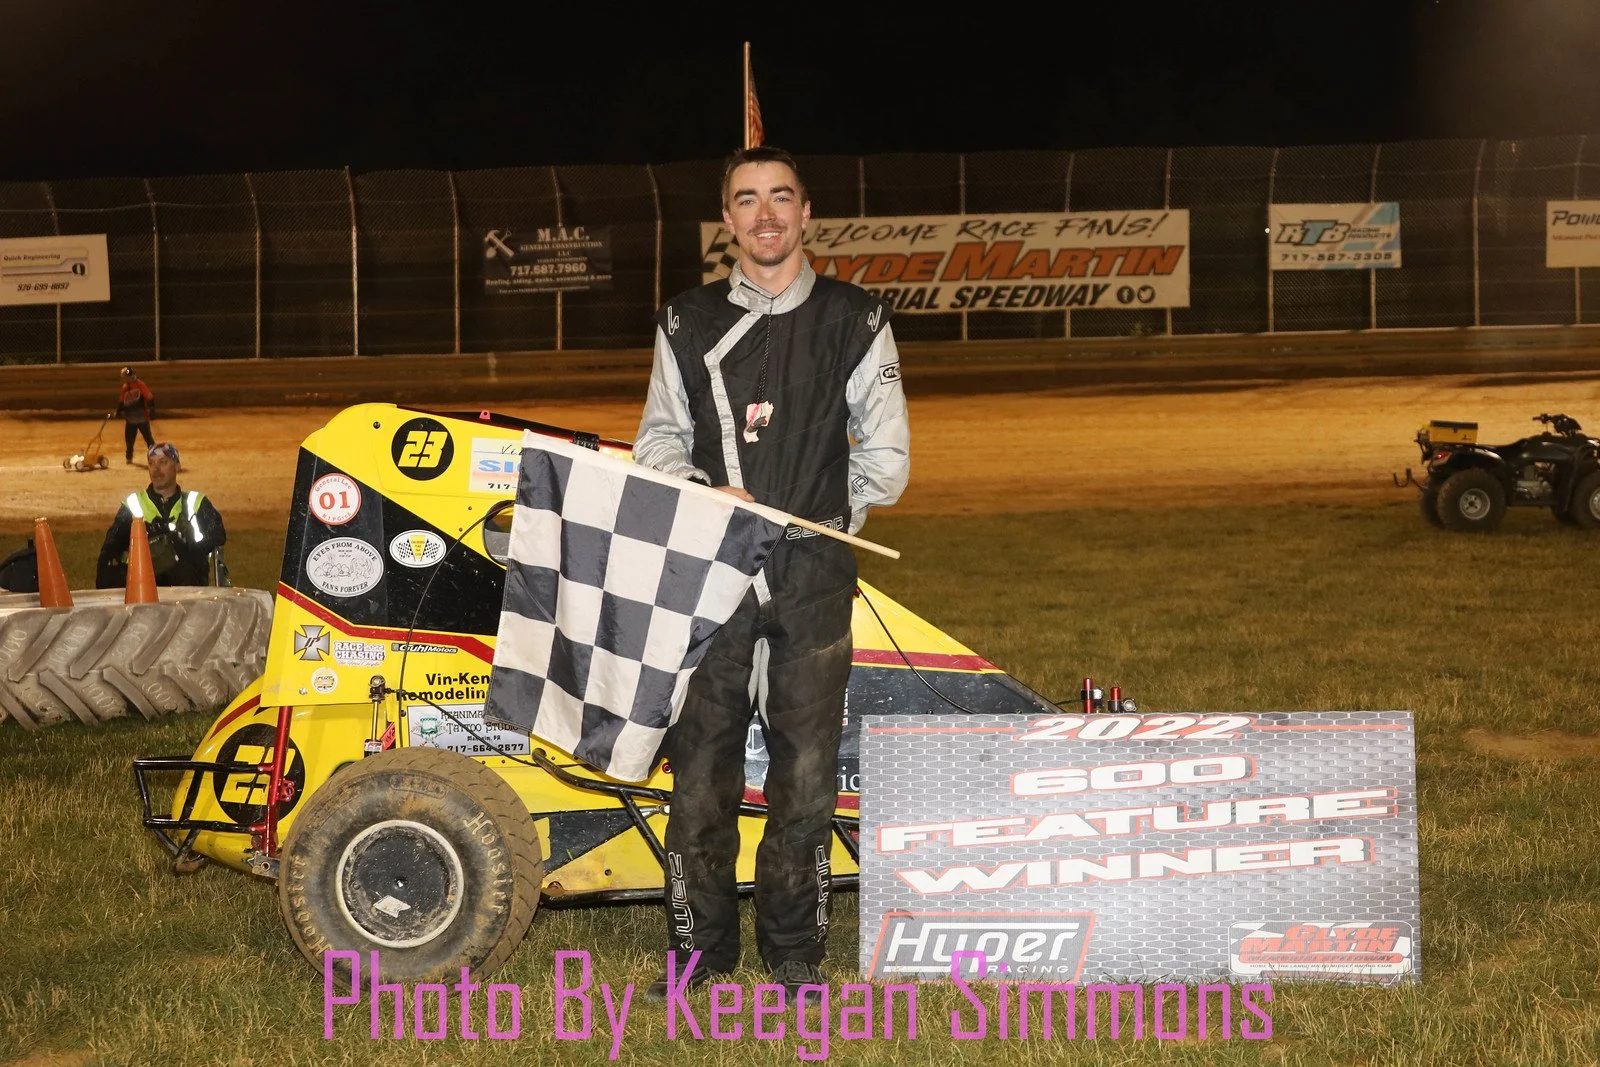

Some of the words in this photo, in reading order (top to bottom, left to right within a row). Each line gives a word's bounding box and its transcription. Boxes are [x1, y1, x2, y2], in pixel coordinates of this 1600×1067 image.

[537, 226, 590, 242] M.A.C.
[956, 218, 1048, 241] RACE
[1055, 212, 1170, 240] FANS!
[802, 249, 946, 285] LYDE
[940, 240, 1186, 282] MARTIN
[866, 287, 943, 312] ORIAL
[950, 283, 1111, 309] SPEEDWAY
[397, 430, 448, 468] 23
[479, 459, 521, 473] SI
[319, 491, 351, 510] 01
[313, 546, 331, 562] EYES
[332, 541, 353, 550] FROM
[355, 544, 378, 562] ABOVE
[340, 581, 369, 593] FOREVER
[334, 642, 365, 652] RACE
[335, 651, 386, 661] CHASING
[426, 672, 490, 686] Vin-Ken
[396, 687, 487, 702] Remodelin
[441, 710, 484, 721] REANIMA
[1015, 715, 1254, 741] 2022
[1011, 756, 1254, 798] 600
[878, 789, 1397, 856] FEATURE
[897, 837, 1373, 896] WINNER
[1284, 924, 1400, 942] CLYDE
[1239, 937, 1395, 953] MARTIN
[986, 965, 1071, 974] RACING
